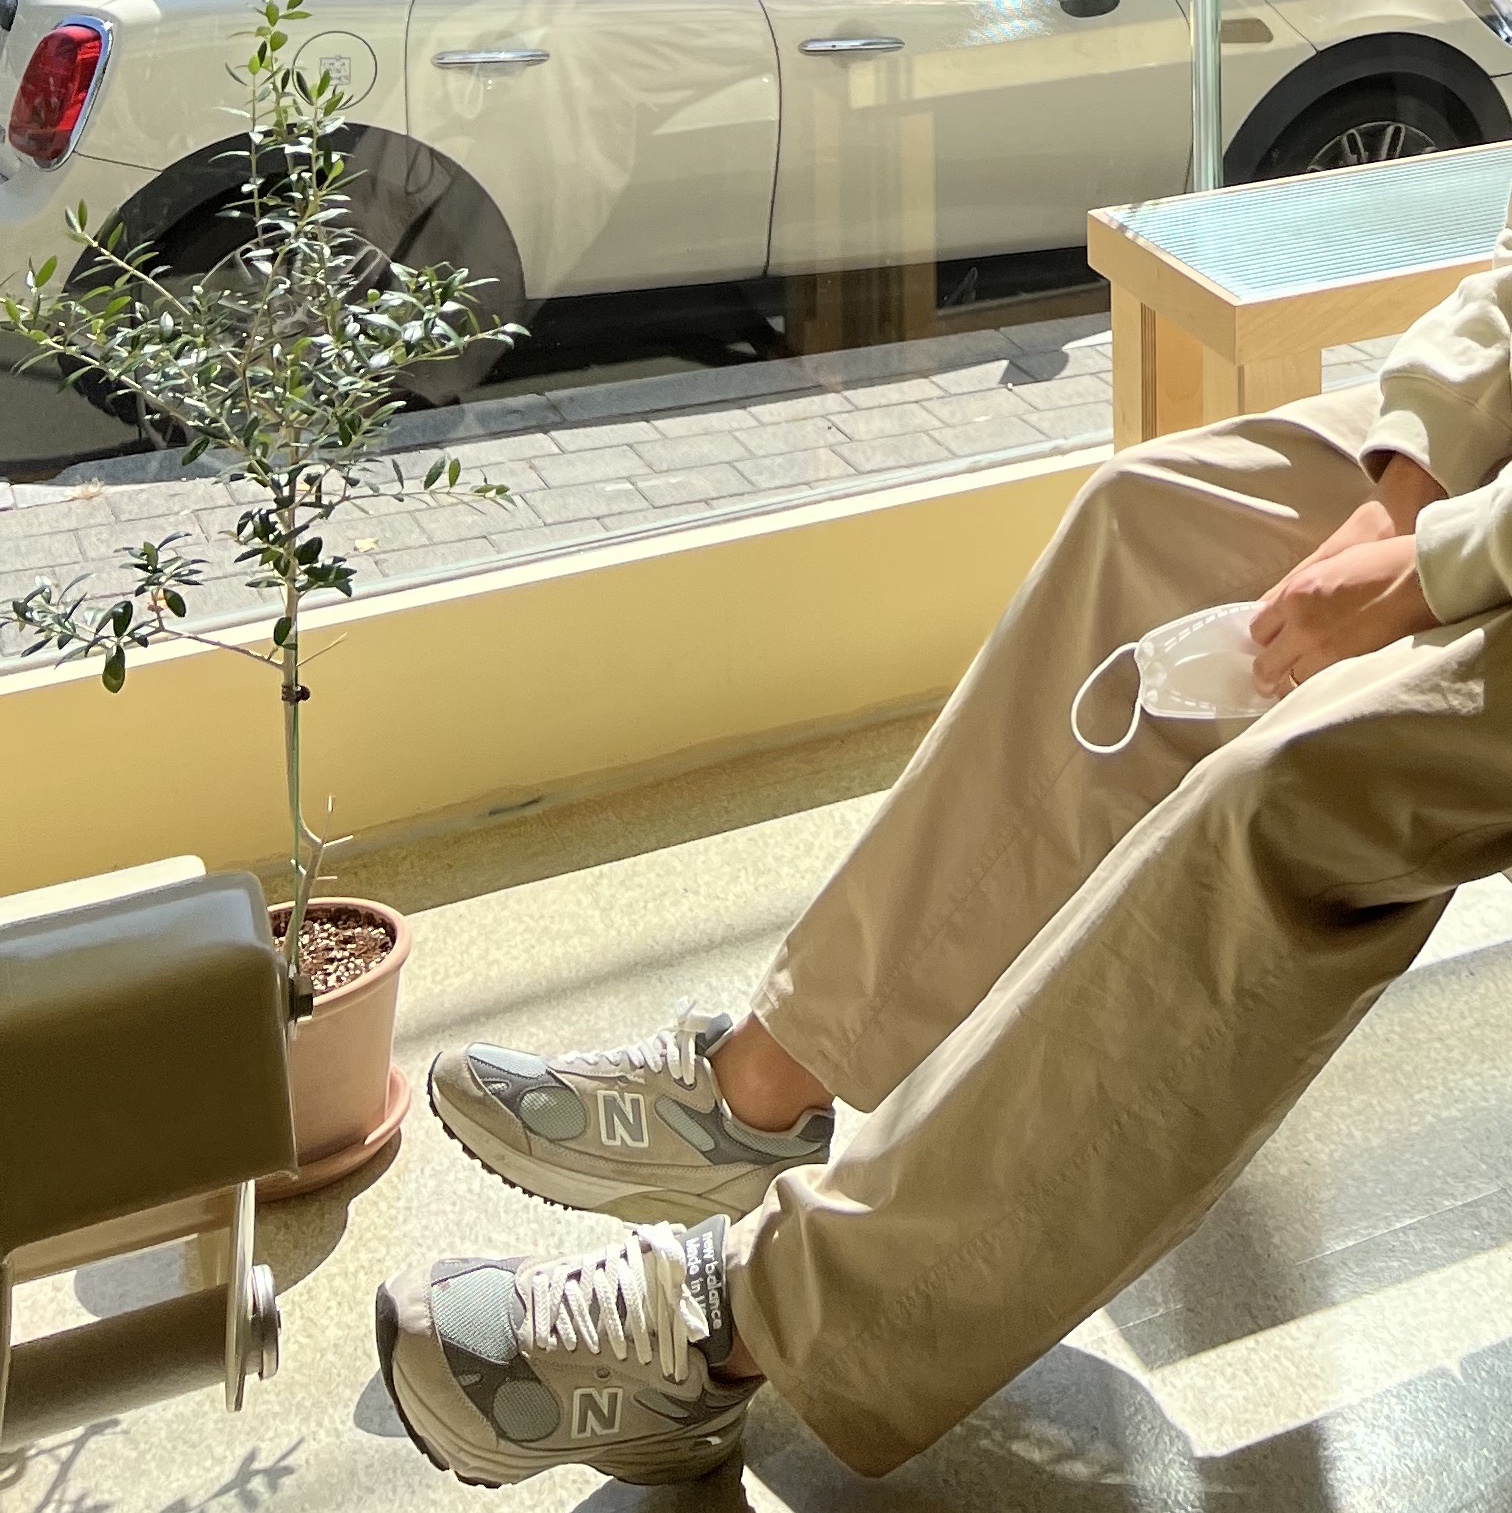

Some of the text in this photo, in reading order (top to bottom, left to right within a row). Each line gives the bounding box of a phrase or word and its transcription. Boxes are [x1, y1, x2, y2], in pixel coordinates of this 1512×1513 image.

[596, 1089, 650, 1148] N
[690, 1277, 703, 1294] in
[702, 1231, 722, 1330] new balance
[571, 1387, 624, 1439] N
